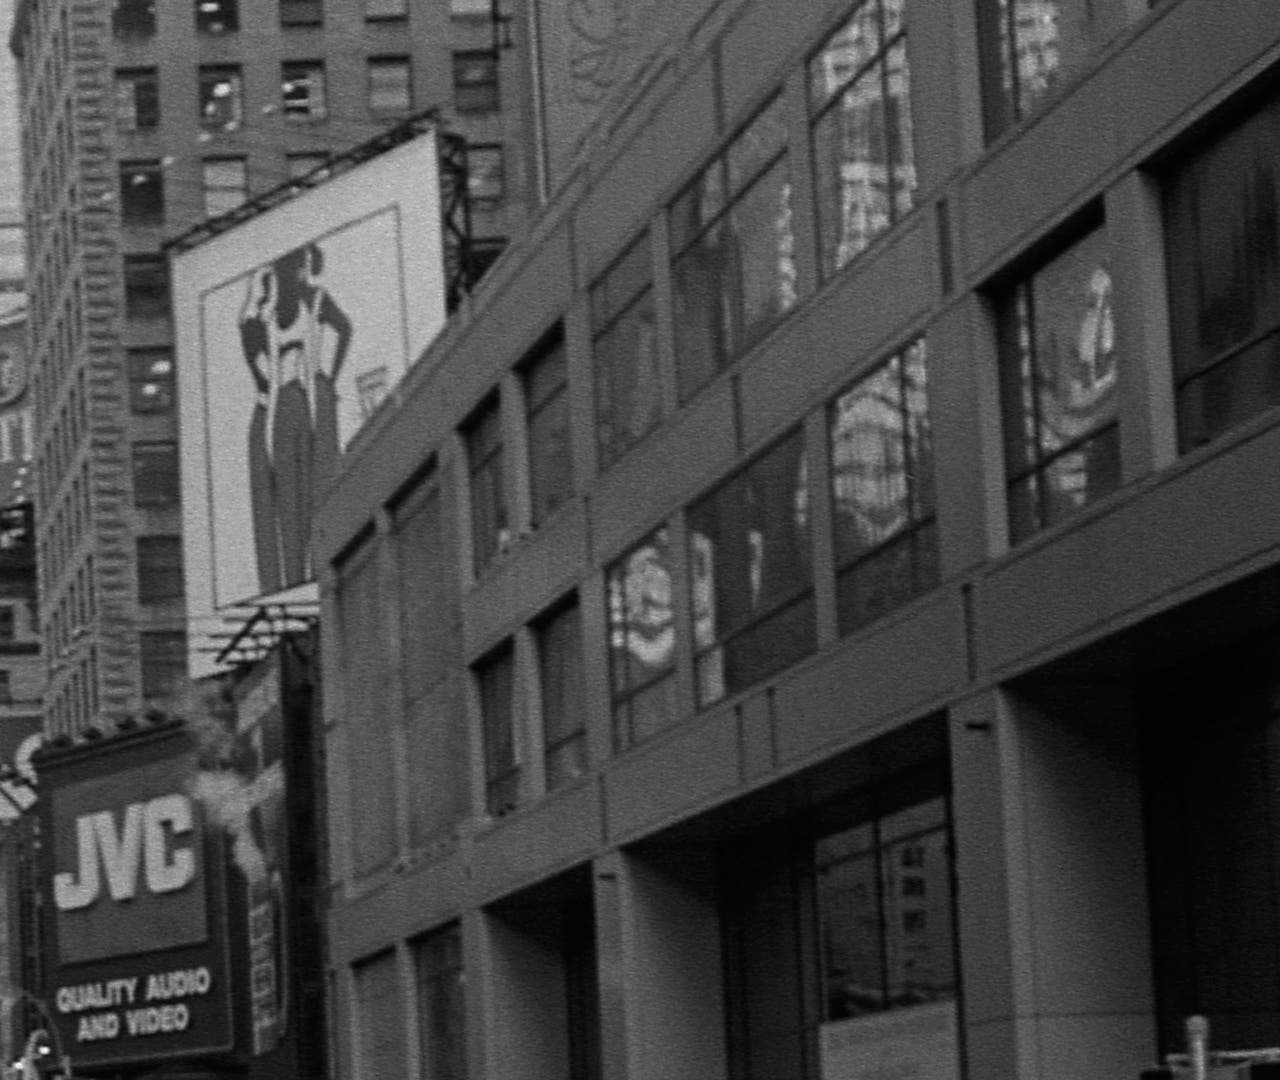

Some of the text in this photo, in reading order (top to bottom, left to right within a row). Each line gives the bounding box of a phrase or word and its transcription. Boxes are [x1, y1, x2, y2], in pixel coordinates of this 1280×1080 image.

[55, 794, 196, 911] JVC
[56, 966, 211, 1013] QUALITY AUDIO
[77, 1003, 189, 1042] AND VIDEO
